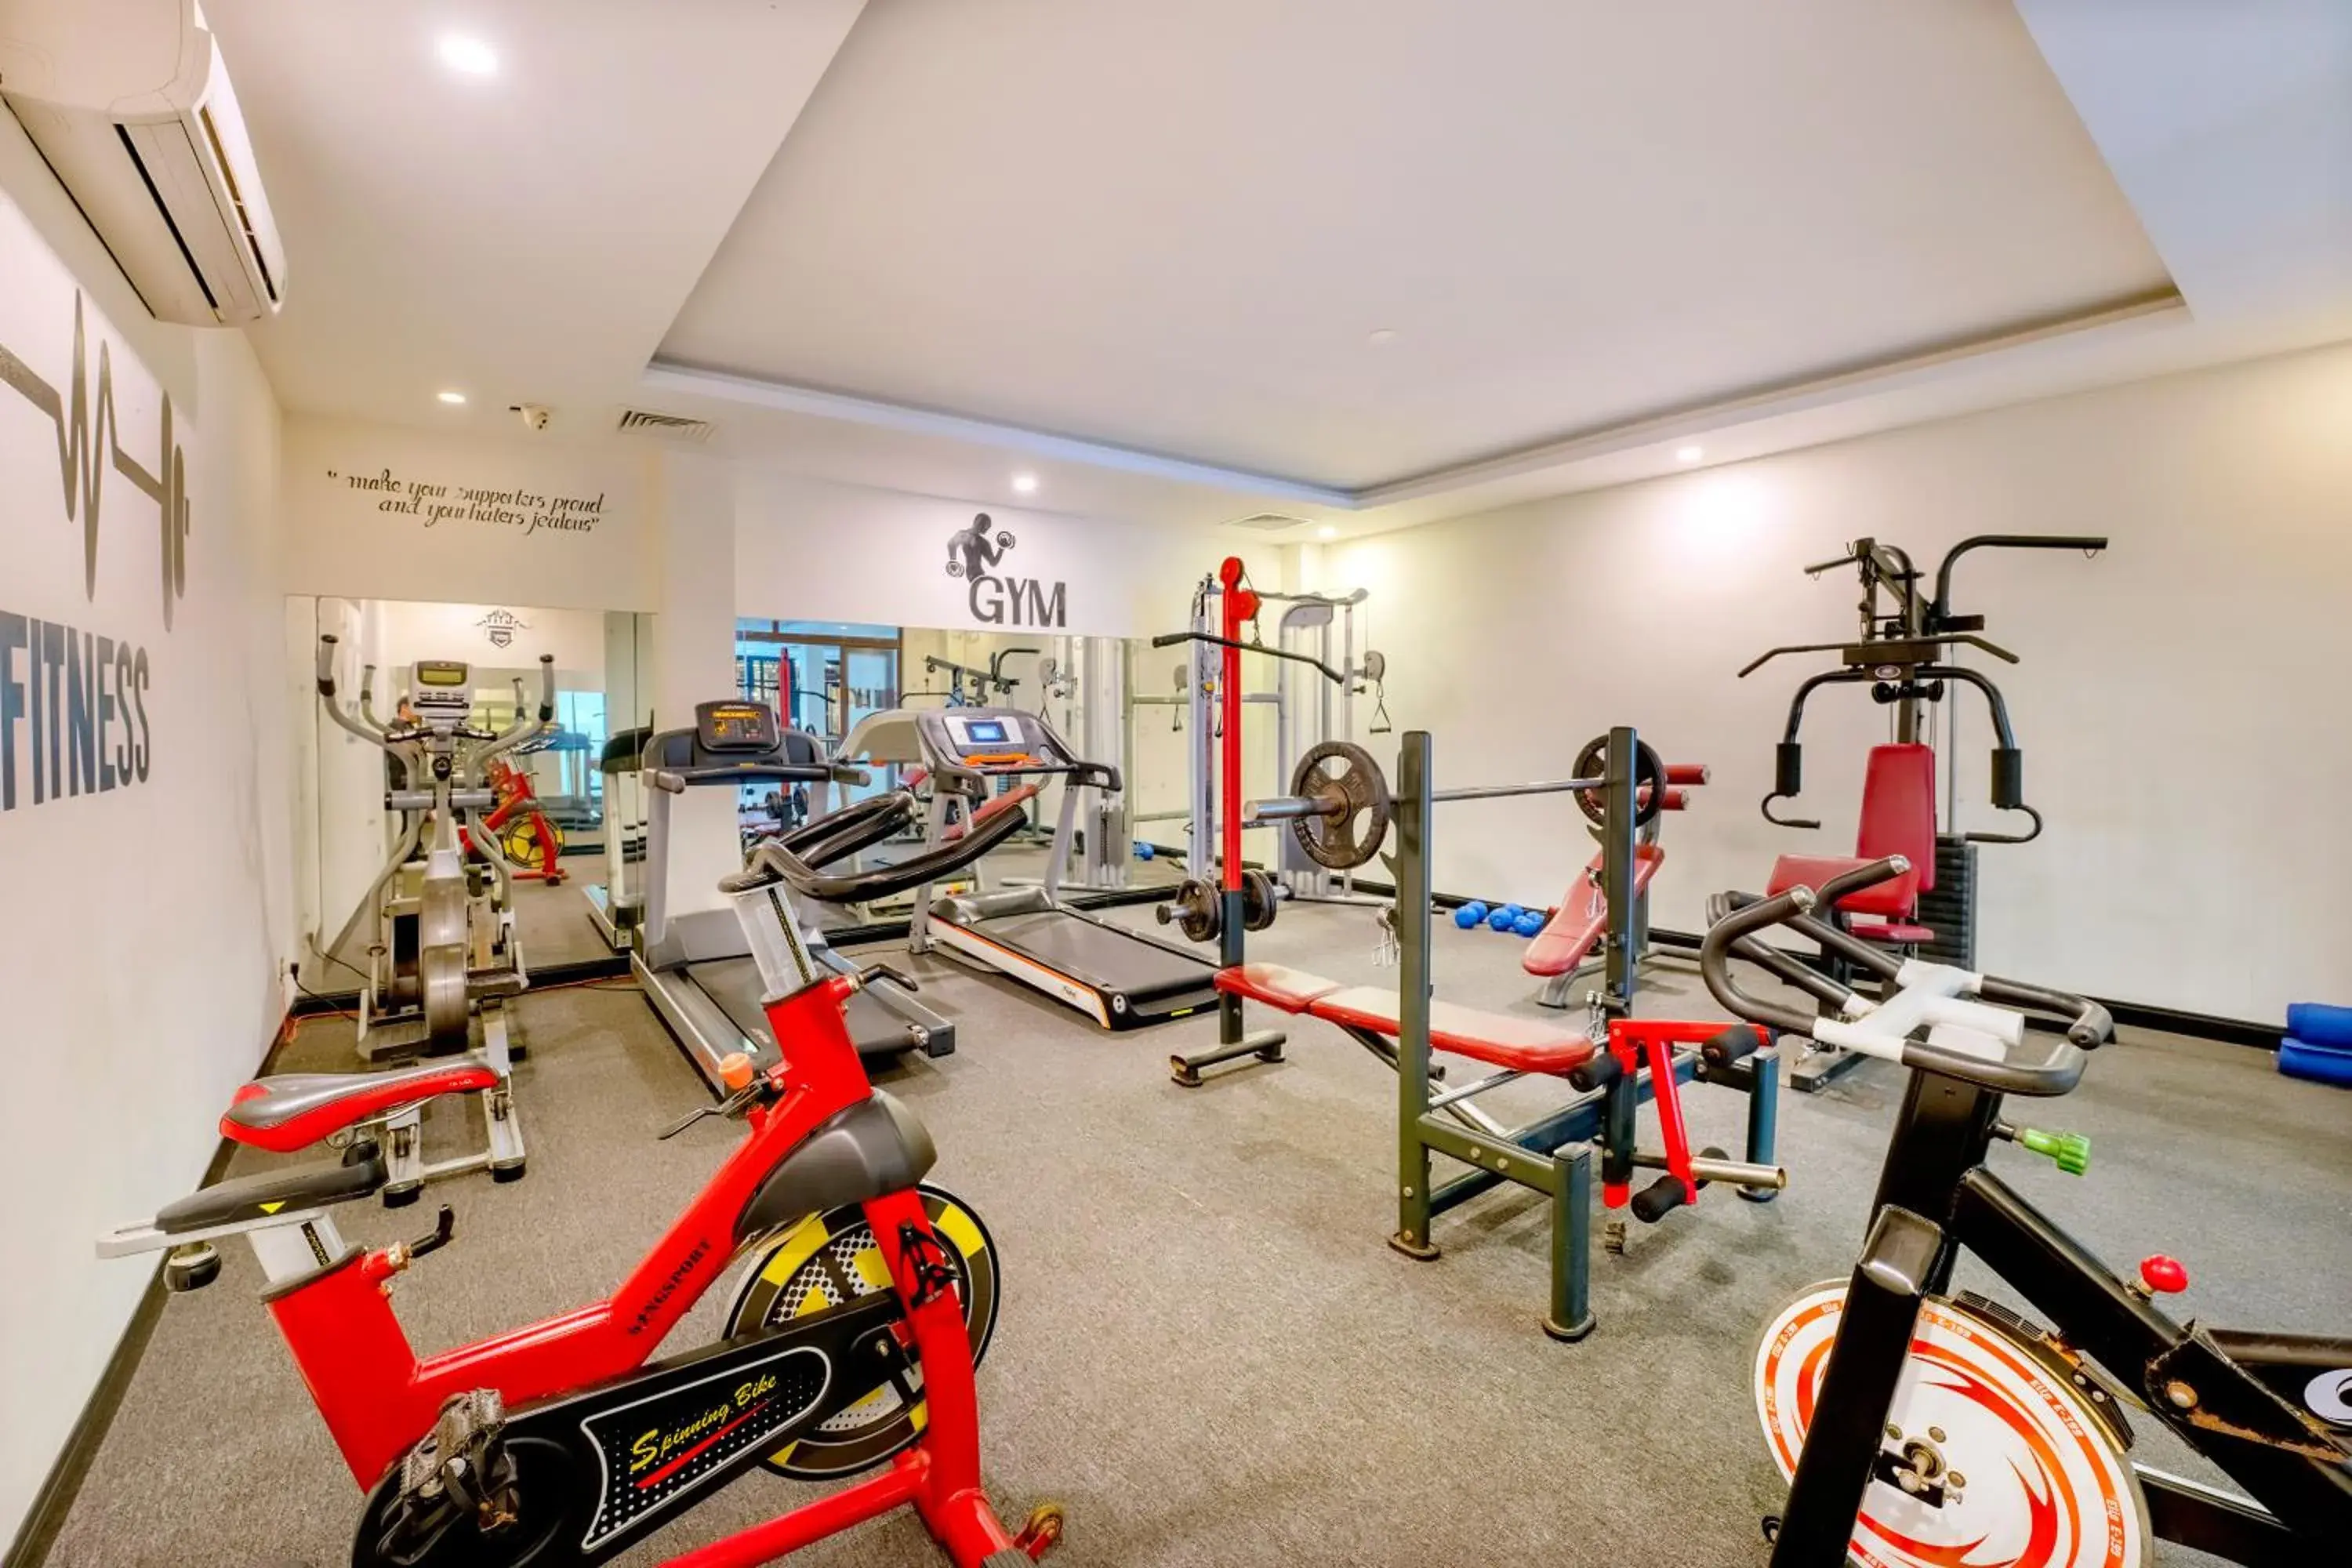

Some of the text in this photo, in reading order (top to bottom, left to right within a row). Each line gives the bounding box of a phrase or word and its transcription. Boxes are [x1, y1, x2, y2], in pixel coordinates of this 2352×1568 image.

[379, 495, 421, 515] and
[423, 503, 466, 528] your
[469, 503, 524, 526] haters
[408, 480, 447, 500] your
[550, 492, 605, 514] proud
[969, 575, 1066, 627] GYM
[0, 610, 149, 811] FITNESS
[630, 1374, 776, 1472] Spinning Bike
